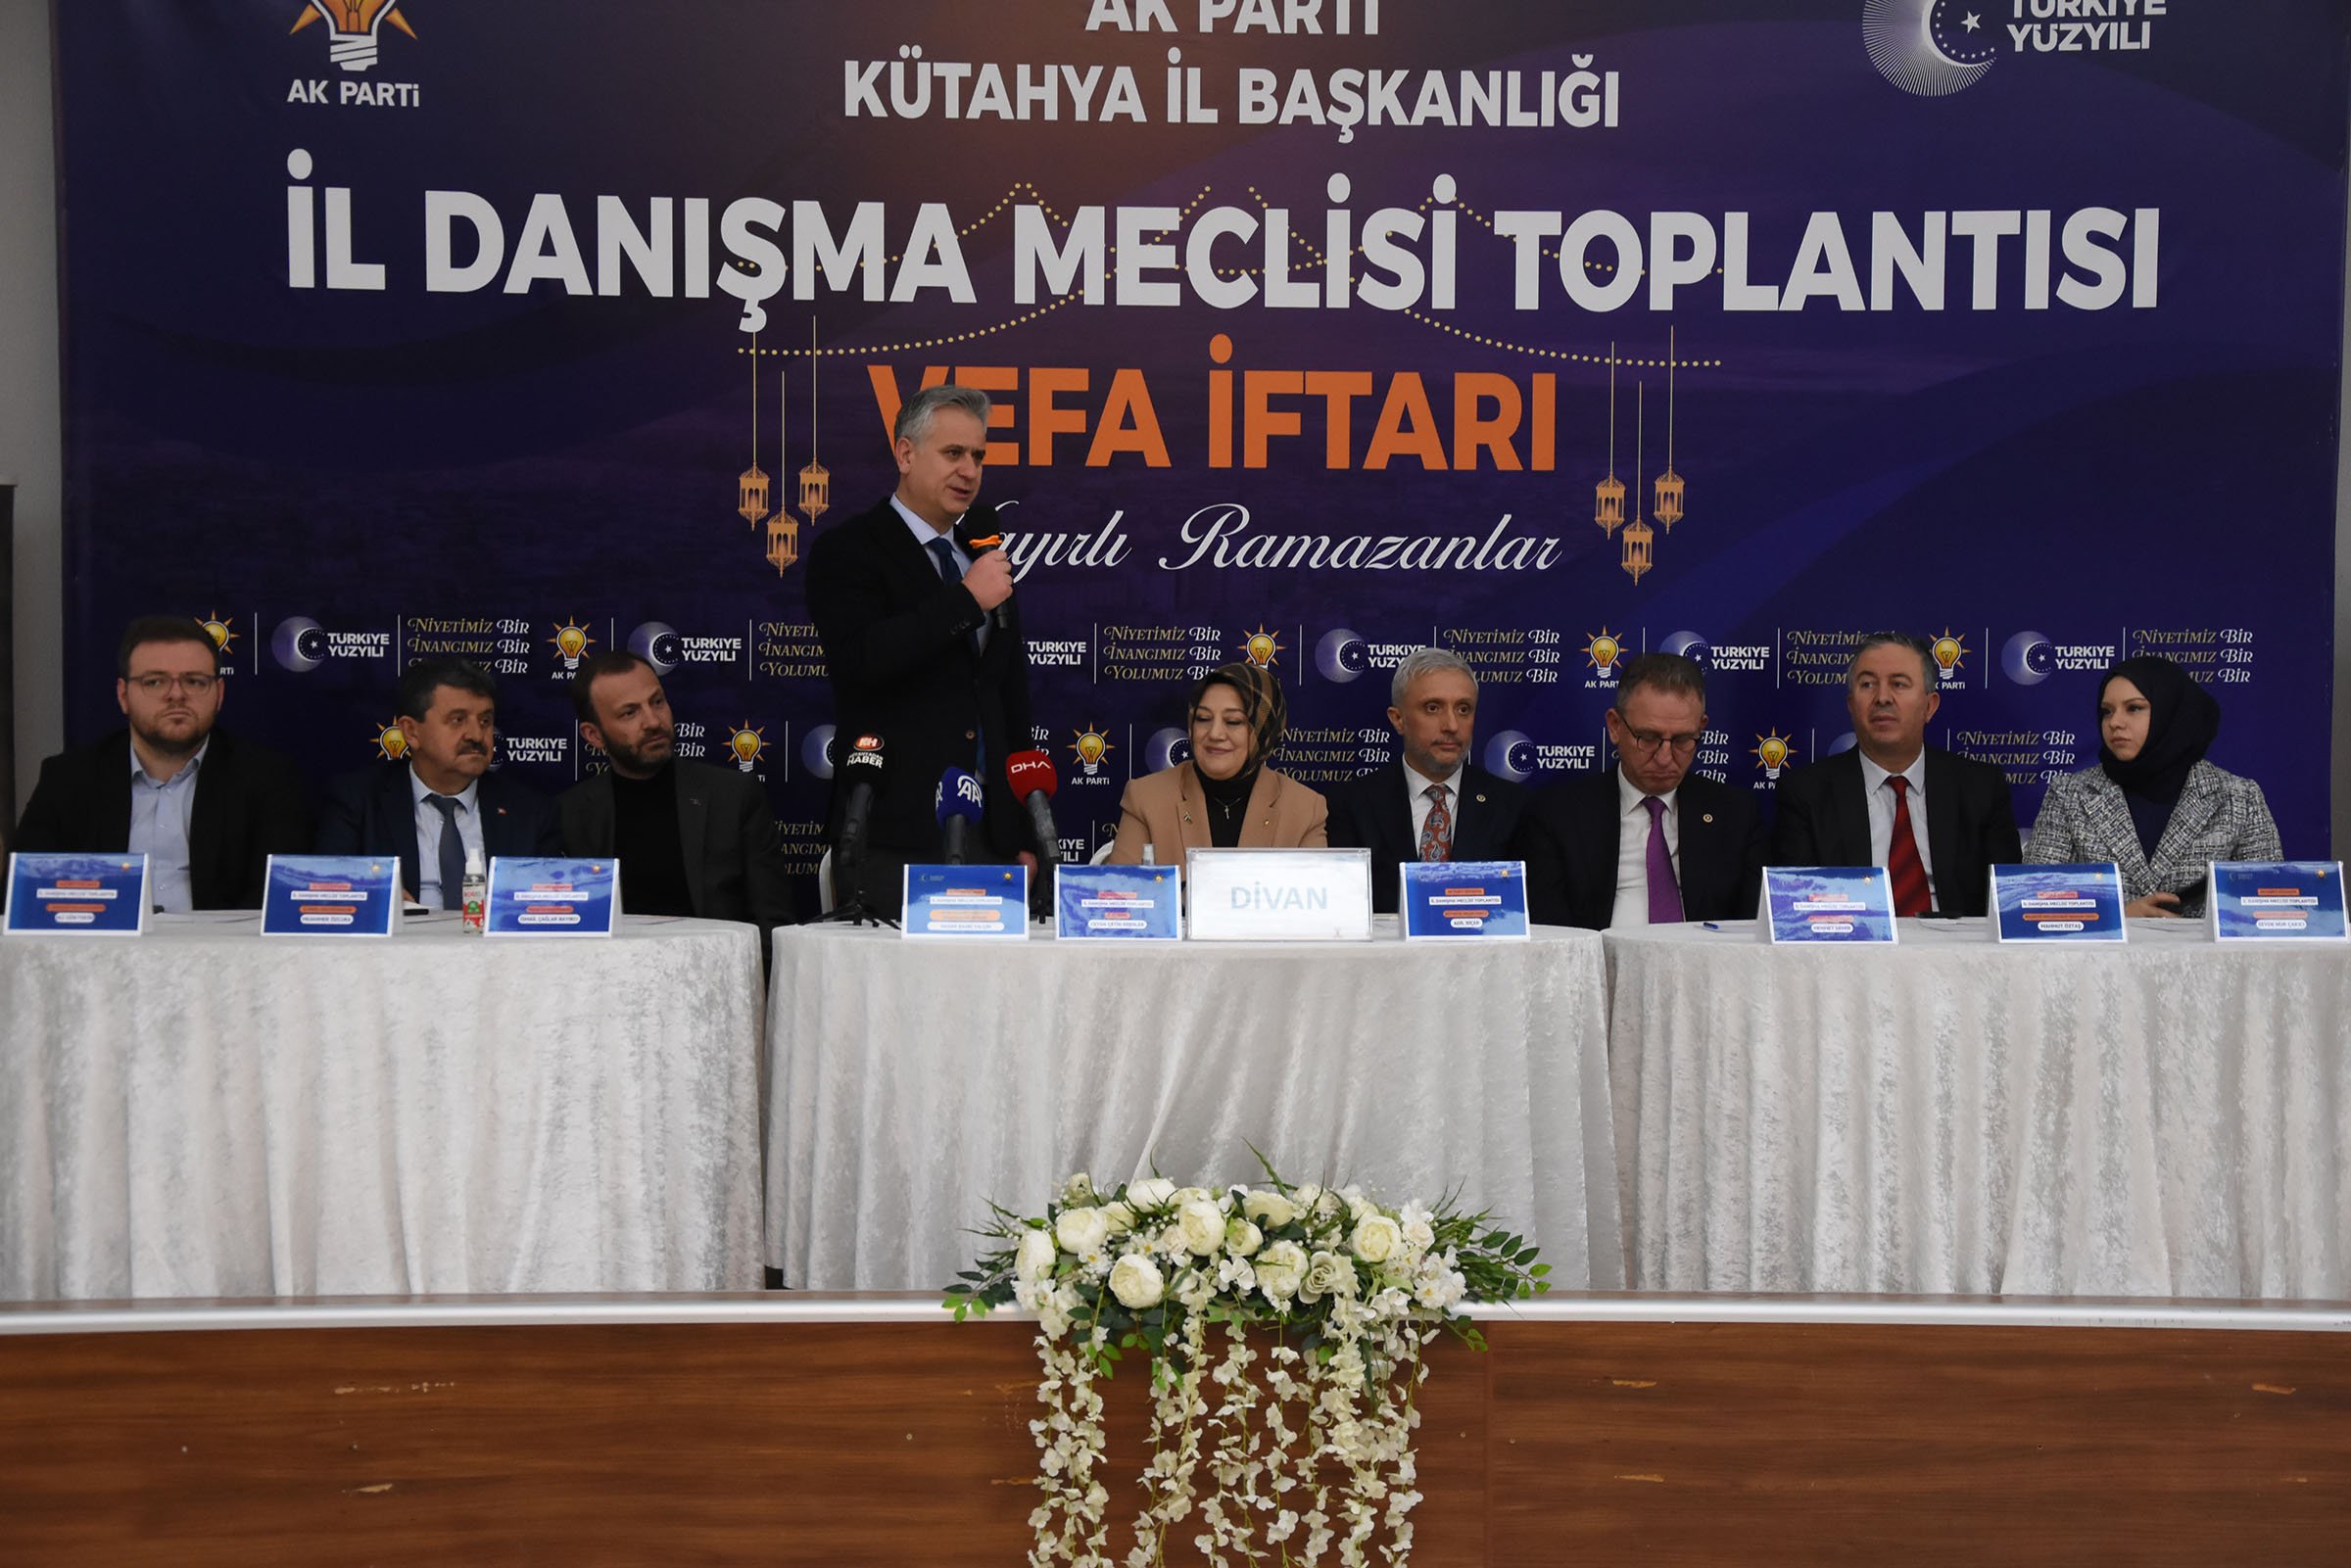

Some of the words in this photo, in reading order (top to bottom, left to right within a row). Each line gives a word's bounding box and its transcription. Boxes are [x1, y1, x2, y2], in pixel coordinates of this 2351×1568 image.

[1084, 0, 1178, 32] AK
[287, 80, 328, 105] AK
[844, 44, 1147, 124] KÜTAHYA
[1167, 47, 1218, 124] İL
[1238, 54, 1620, 144] BAŞKANLIĞI
[287, 148, 386, 291] İL
[425, 190, 977, 333] DANIŞMA
[1014, 173, 1456, 311] MECLİSİ
[1494, 207, 2160, 312] TOPLANTISI
[1208, 333, 1556, 471] İFTARI
[956, 499, 1132, 584] ayırlı
[1159, 502, 1562, 572] Ramazanlar
[408, 617, 494, 634] NİYETİMİZ
[497, 619, 530, 635] BİR
[759, 622, 819, 637] NİYETİ
[1103, 625, 1186, 641] NİYETİMİZ
[1188, 626, 1222, 641] BİR
[1443, 629, 1525, 643] NİYETİMİZ
[1528, 629, 1560, 644] BİR
[1787, 630, 1867, 645] NİYETİMİ
[2132, 629, 2217, 643] NİYETİMİZ
[2220, 628, 2253, 643] BİR
[408, 635, 494, 653] İNANCIMIZ
[497, 639, 530, 654] BİR
[758, 638, 825, 657] İNANCIM
[1103, 641, 1186, 660] İNANCIMIZ
[1189, 645, 1222, 661] BİR
[1528, 648, 1560, 664] BİR
[1786, 646, 1854, 665] İNANCIM
[2132, 645, 2217, 663] İNCIMIZ
[2221, 648, 2253, 663] BİR
[495, 658, 528, 674] BİR
[759, 661, 830, 677] YOLUMU
[1367, 657, 1406, 668] YÜZY
[1104, 665, 1184, 680] YOLUMUZ
[1187, 666, 1215, 681] Bİ
[1472, 670, 1523, 684] LUMUZ
[1526, 668, 1559, 684] BİR
[1787, 670, 1847, 685] YOLUM
[2218, 668, 2250, 683] BİR
[1584, 680, 1597, 689] AK
[1600, 680, 1619, 689] PART
[674, 723, 705, 737] BİR
[1280, 728, 1355, 742] NİYETİMİZ
[1358, 729, 1390, 743] BİR
[1702, 730, 1729, 744] BİR
[1956, 731, 2039, 745] NİYETİMİZ
[2042, 730, 2075, 745] BİR
[674, 742, 705, 757] BİR
[1273, 743, 1356, 762] İNANCIMIZ
[1359, 747, 1390, 763] BİR
[1698, 749, 1729, 764] BİR
[2042, 749, 2075, 764] BİR
[846, 755, 883, 769] HABER
[1011, 761, 1051, 774] DHA
[1072, 777, 1083, 785] AK
[957, 781, 983, 808] AA
[1230, 881, 1328, 910] DİVAN
